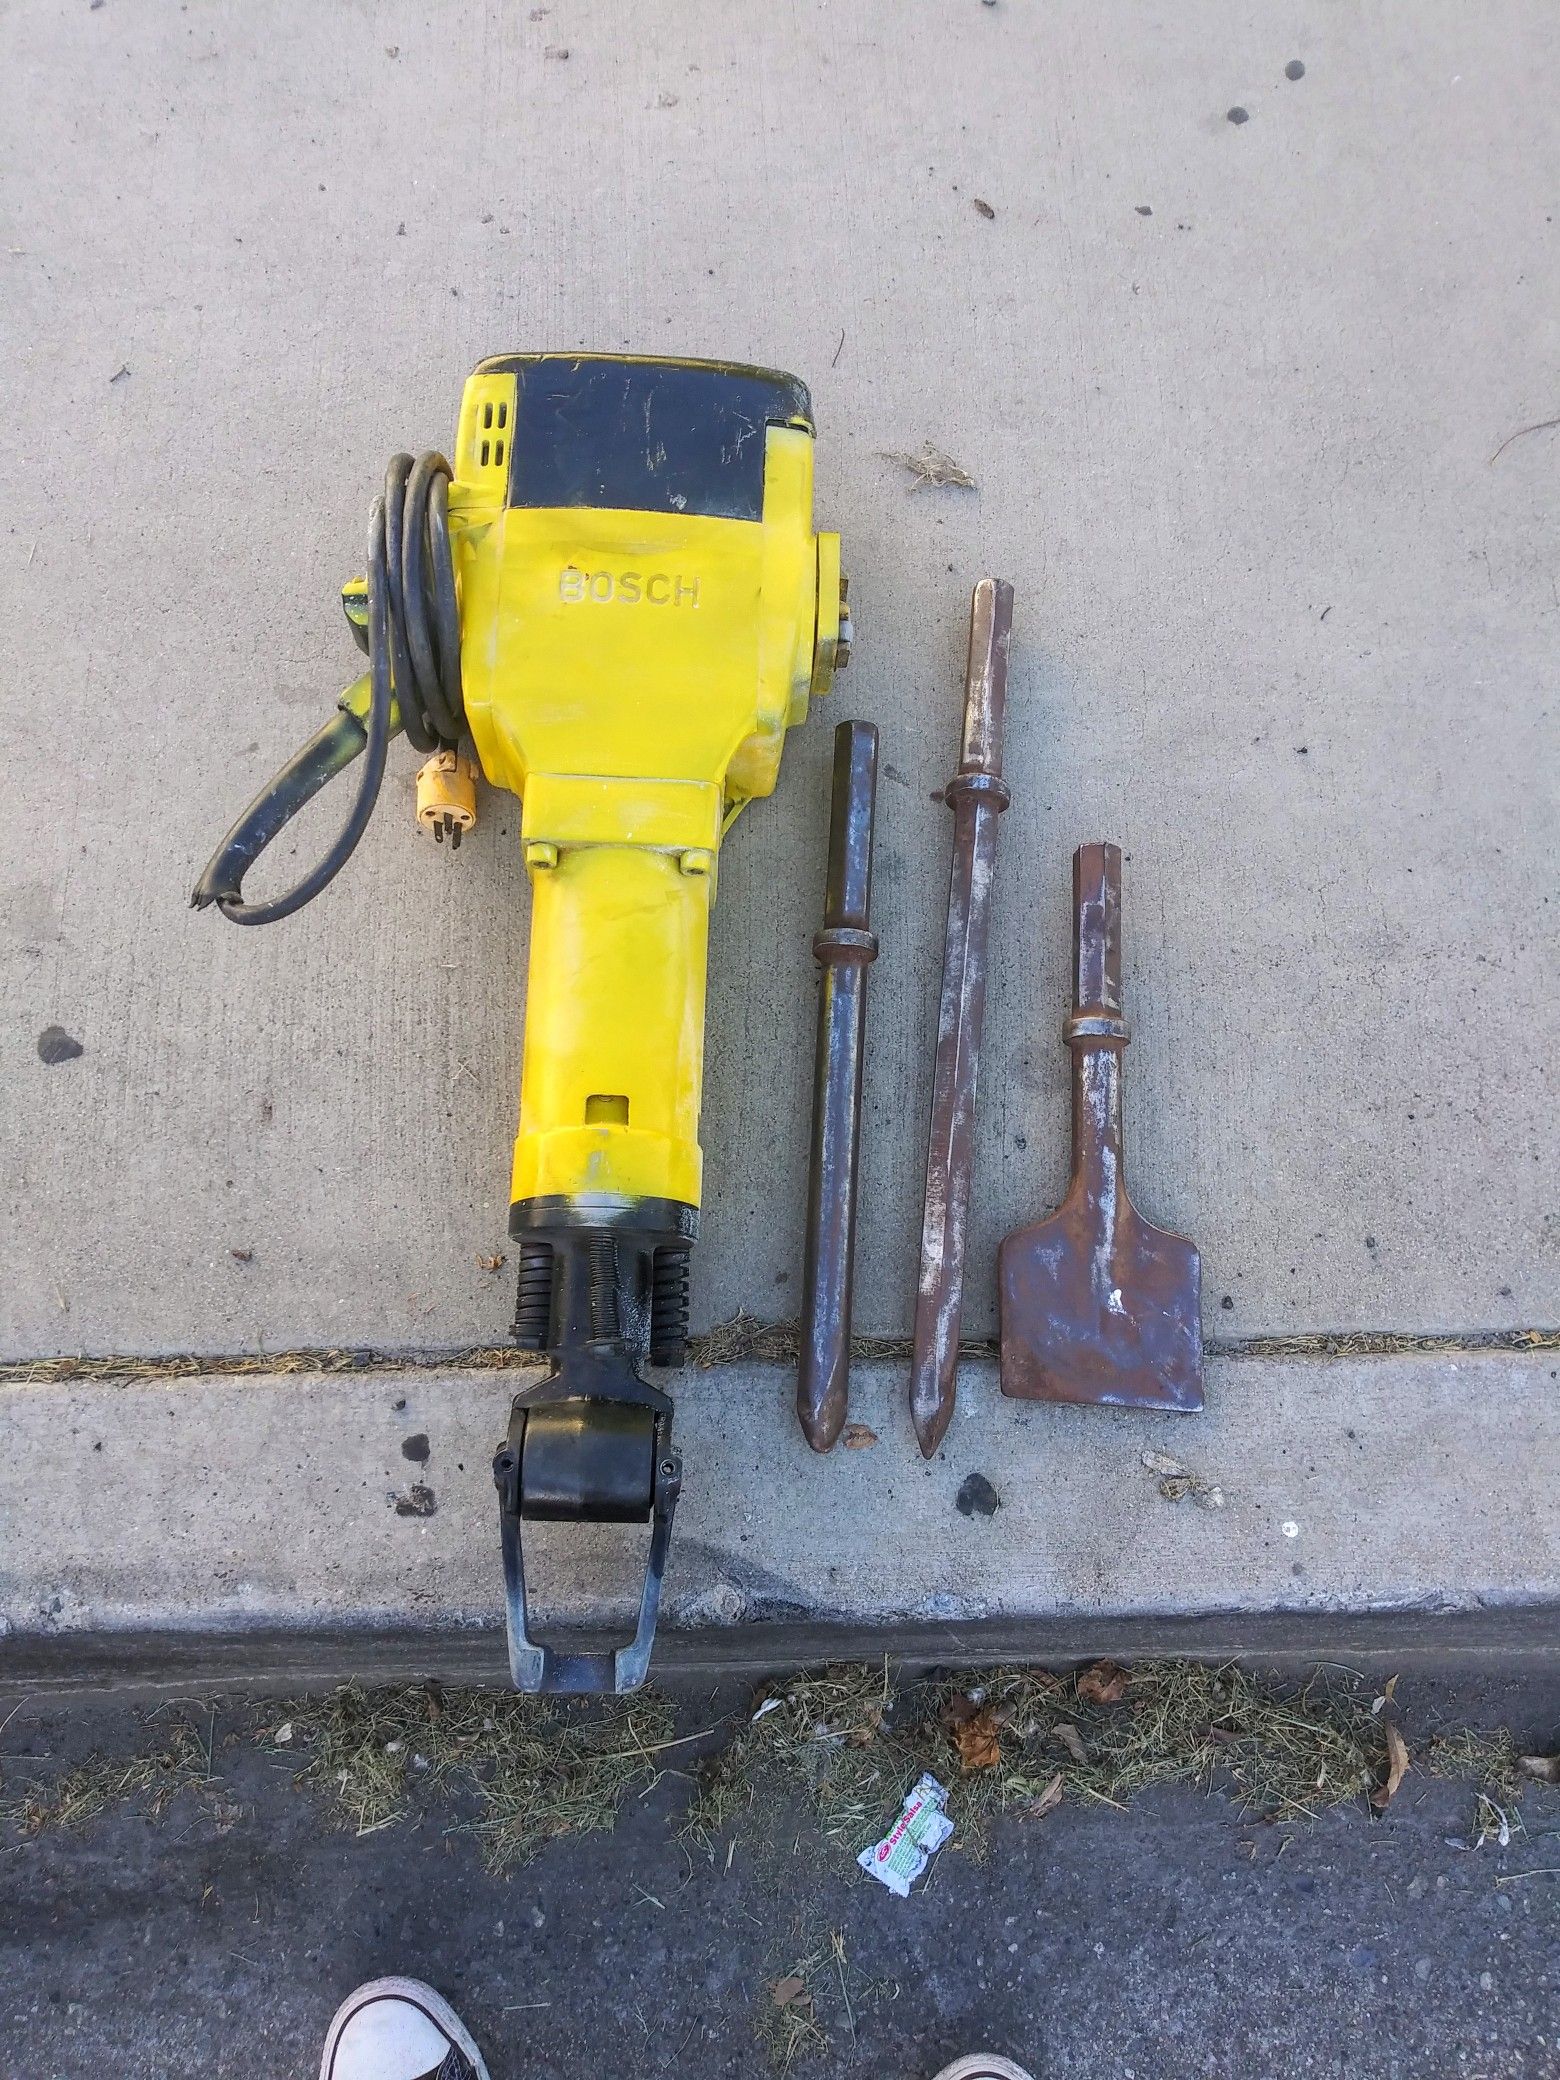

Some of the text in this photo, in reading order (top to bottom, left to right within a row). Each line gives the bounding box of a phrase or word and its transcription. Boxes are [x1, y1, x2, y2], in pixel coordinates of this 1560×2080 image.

[559, 569, 701, 609] BOSCH
[889, 1823, 906, 1845] Style
[903, 1801, 922, 1827] Salsa
